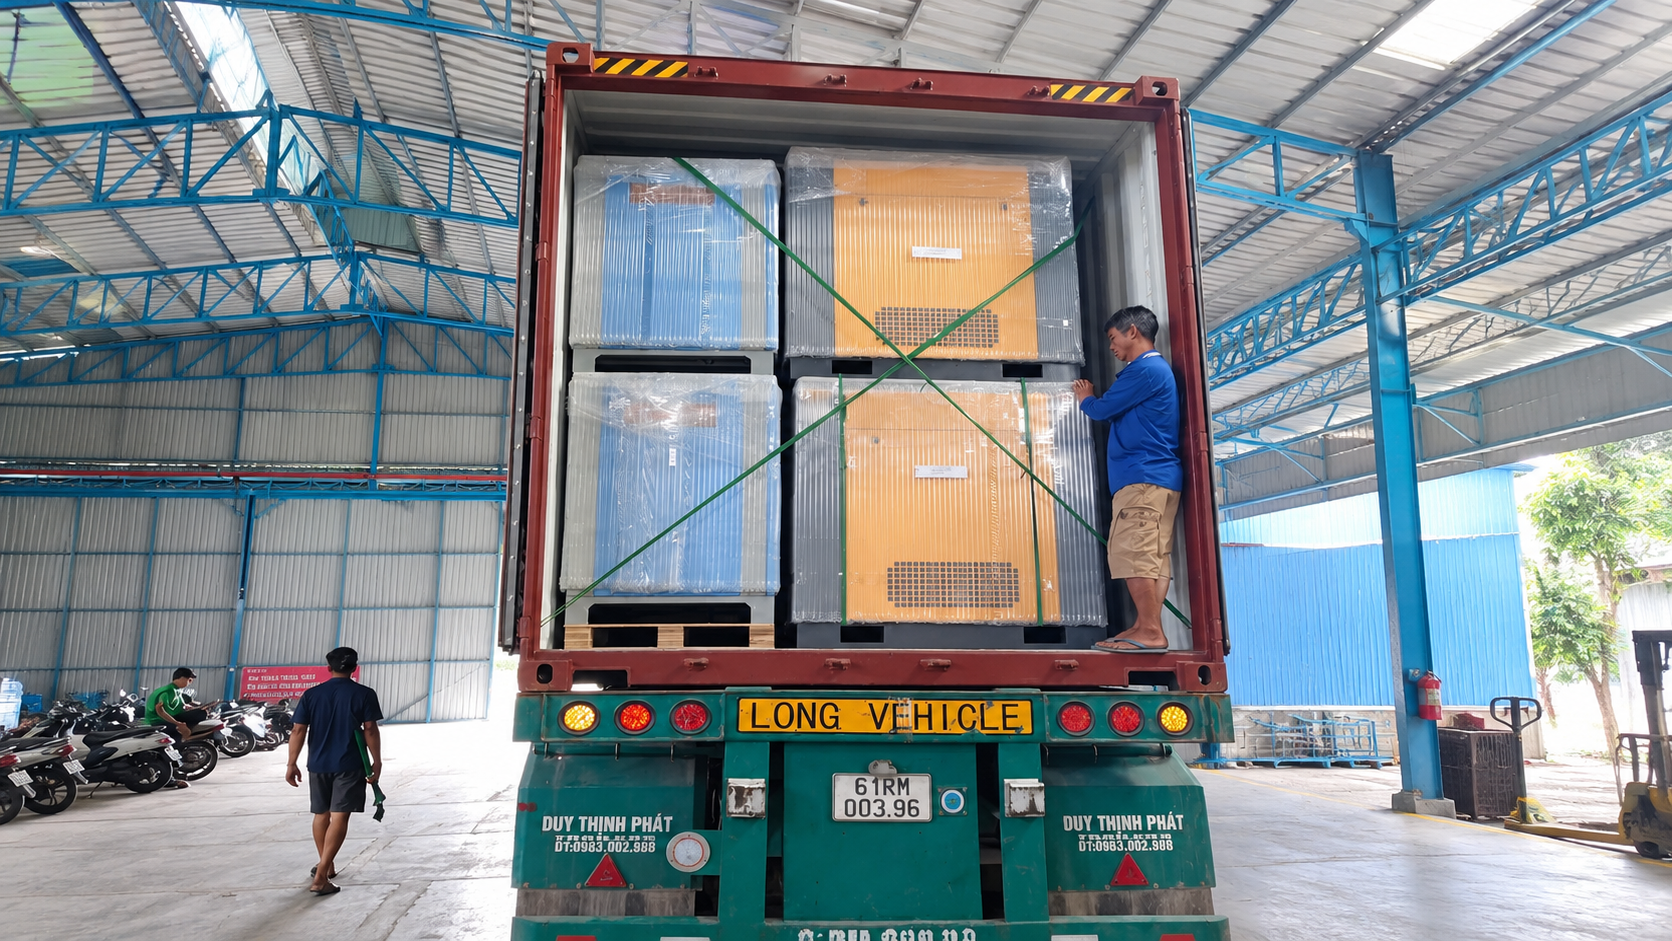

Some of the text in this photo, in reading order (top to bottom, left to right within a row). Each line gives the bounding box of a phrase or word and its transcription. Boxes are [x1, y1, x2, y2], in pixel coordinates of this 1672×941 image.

[751, 701, 1020, 731] LONG VEHICLE
[855, 777, 910, 796] 61RM
[844, 798, 920, 818] 003.96
[542, 812, 673, 836] DUY THỊNH PHÁT
[1062, 811, 1184, 835] DUY THỊNH PHÁT
